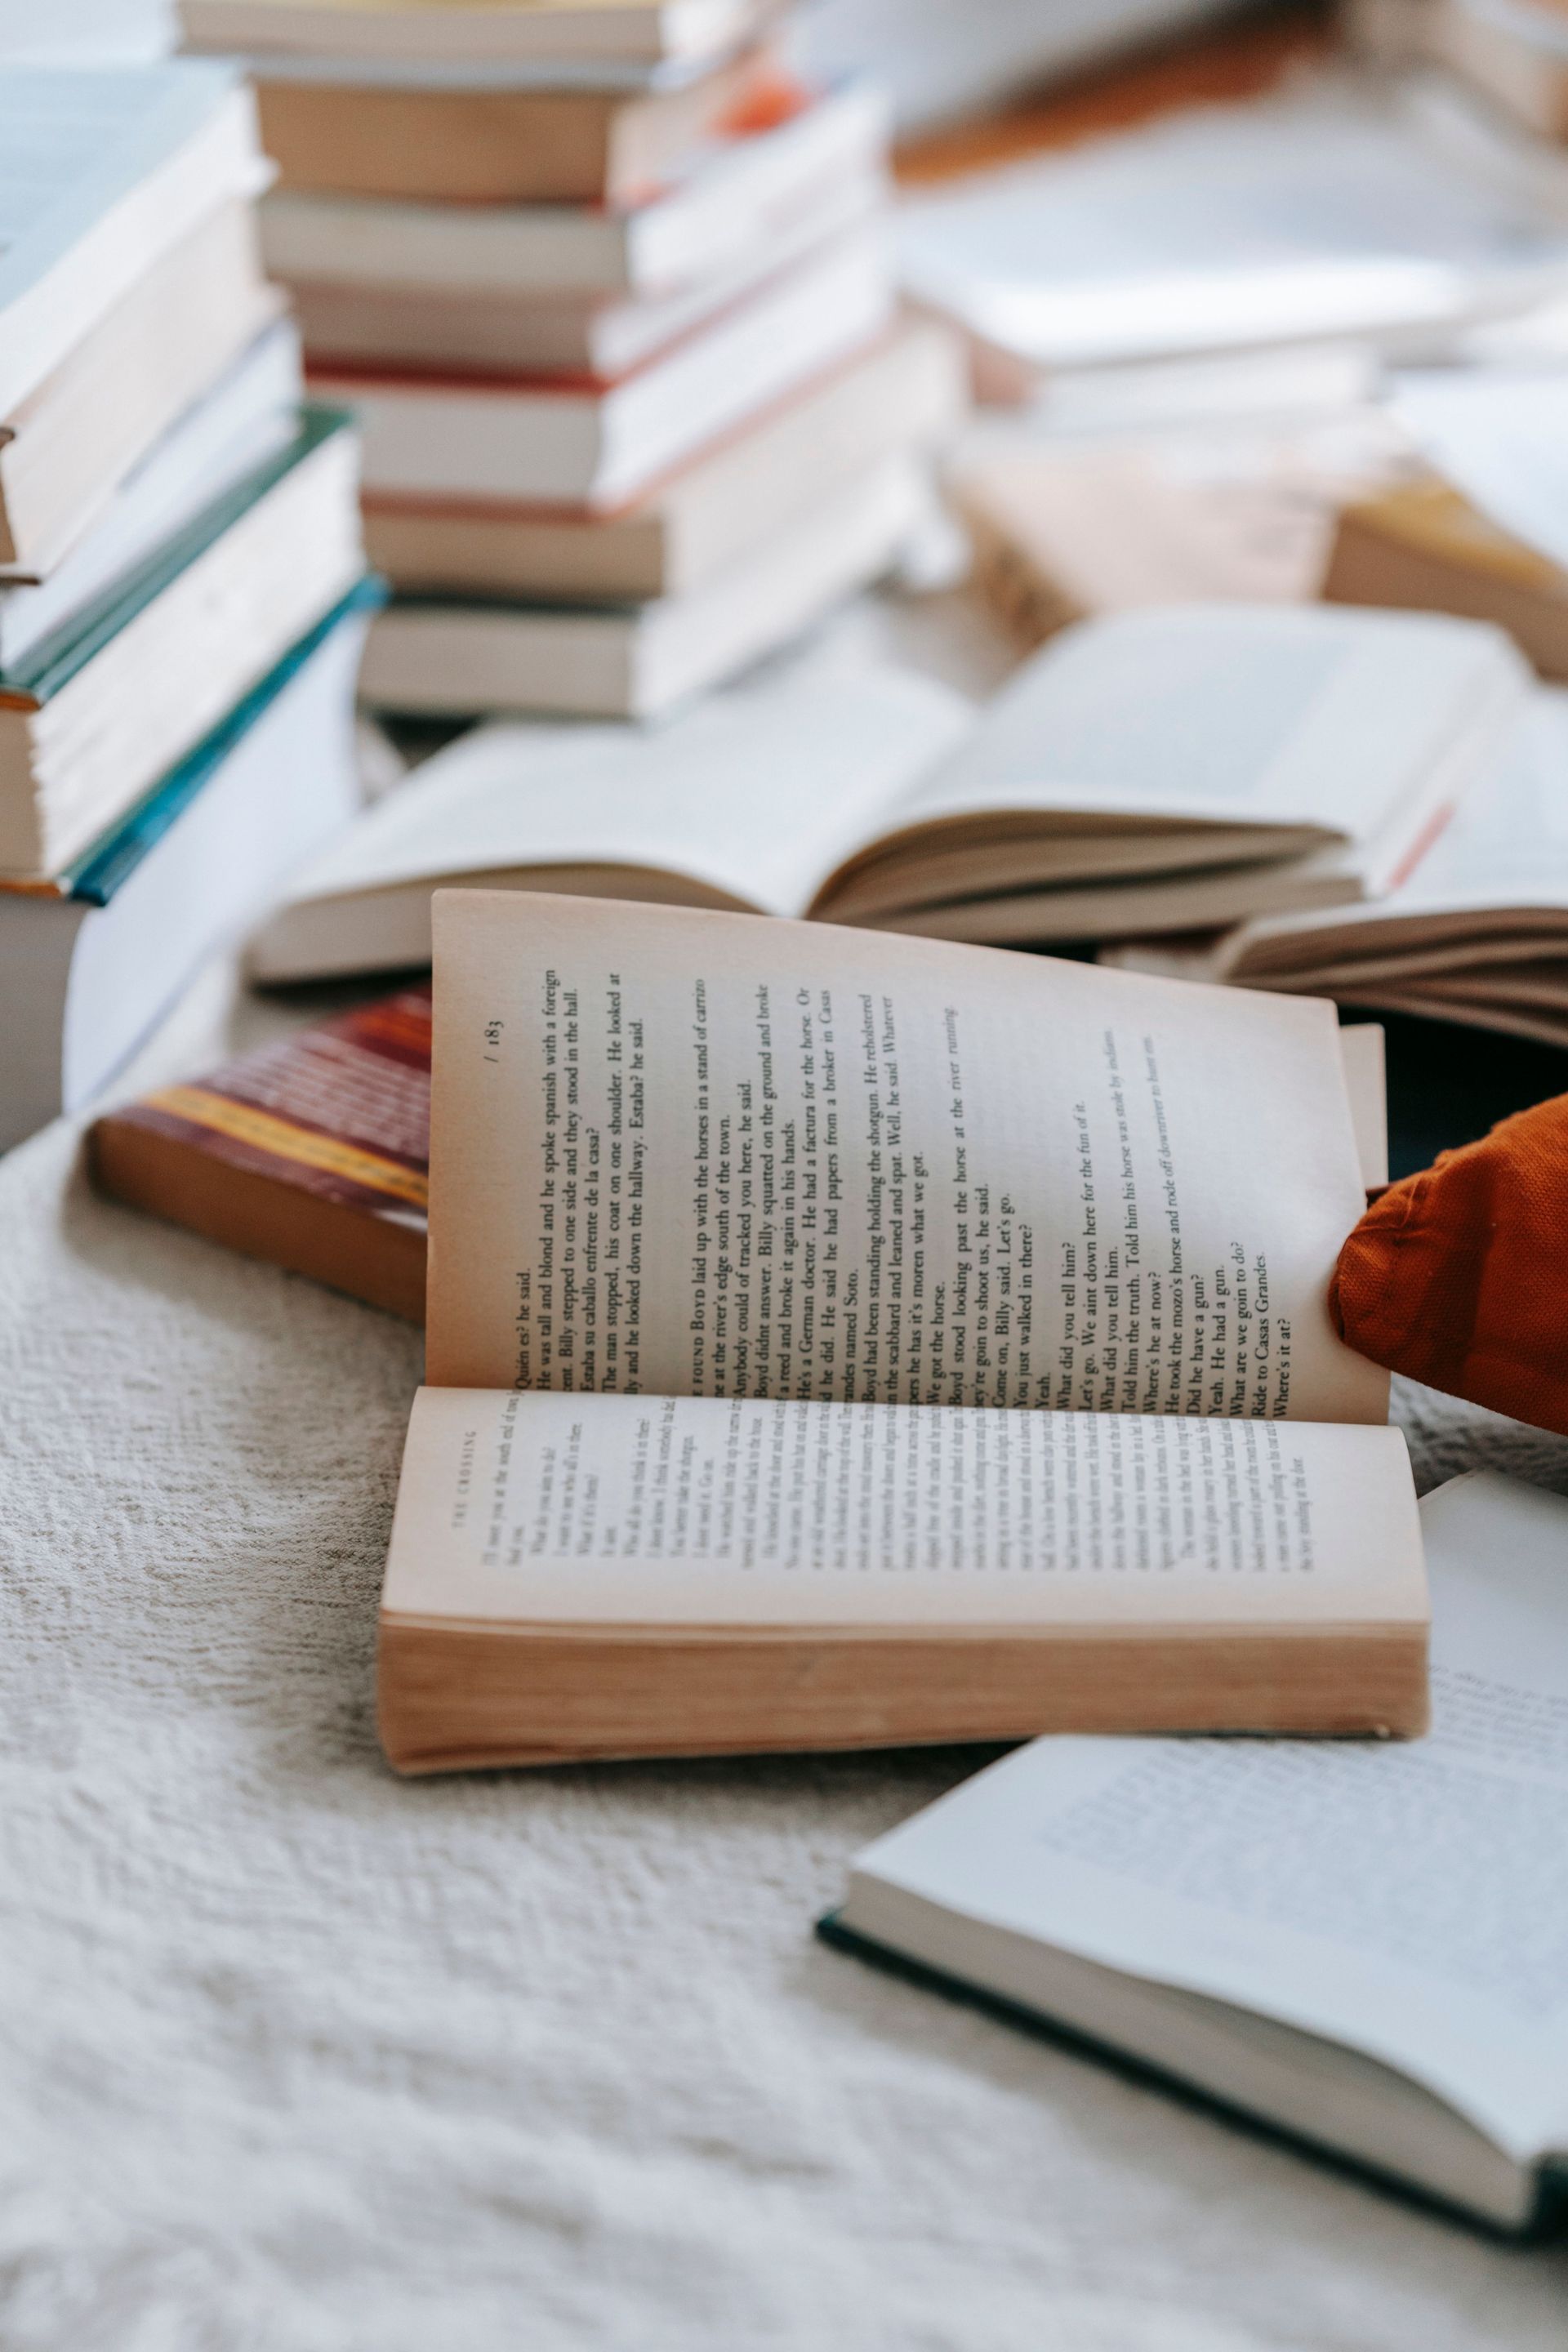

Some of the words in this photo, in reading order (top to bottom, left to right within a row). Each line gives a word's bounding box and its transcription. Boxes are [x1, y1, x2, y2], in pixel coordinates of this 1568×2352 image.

[541, 970, 560, 1016] foreign
[564, 989, 577, 1017] hall.
[607, 991, 621, 1034] looked
[485, 1021, 503, 1045] 183
[542, 1035, 556, 1066] with
[628, 1019, 643, 1049] said.
[693, 1045, 708, 1080] stand
[758, 1052, 777, 1099] ground
[822, 1049, 835, 1091] broker
[884, 1059, 898, 1087] said.
[950, 1062, 961, 1090] river
[542, 1072, 559, 1125] spanish
[564, 1067, 578, 1104] stood
[608, 1071, 621, 1135] shoulder.
[629, 1076, 644, 1129] Estaba?
[737, 1080, 751, 1110] said.
[564, 1111, 581, 1143] they
[719, 1116, 730, 1155] town.
[802, 1106, 816, 1152] factura
[823, 1113, 838, 1146] from
[866, 1090, 883, 1146] shotgun.
[887, 1111, 901, 1146] Well,
[541, 1132, 559, 1173] spoke
[586, 1128, 599, 1165] casa?
[694, 1115, 709, 1160] horses
[781, 1120, 795, 1164] hands.
[1077, 1134, 1090, 1153] fun
[628, 1136, 647, 1197] hallway.
[737, 1138, 753, 1174] here,
[892, 1153, 906, 1184] spat.
[913, 1152, 929, 1177] got.
[953, 1147, 967, 1183] horse
[1120, 1146, 1134, 1178] horse
[742, 1180, 755, 1207] you
[760, 1154, 777, 1215] squatted
[828, 1153, 843, 1200] papers
[1163, 1180, 1177, 1206] rode
[562, 1181, 577, 1209] side
[693, 1194, 707, 1227] with
[867, 1176, 884, 1231] holding
[975, 1184, 989, 1214] said.
[609, 1201, 620, 1232] coat
[715, 1209, 729, 1250] south
[911, 1209, 924, 1244] what
[1082, 1206, 1096, 1236] here
[582, 1212, 598, 1272] enfrente
[626, 1233, 641, 1274] down
[737, 1214, 751, 1267] tracked
[758, 1222, 777, 1256] Billy
[781, 1217, 798, 1255] again
[888, 1220, 902, 1267] leaned
[957, 1223, 972, 1252] past
[996, 1219, 1010, 1254] Let's
[1018, 1224, 1032, 1268] there?
[1125, 1234, 1139, 1267] Told
[538, 1237, 553, 1278] blond
[692, 1258, 706, 1284] laid
[714, 1256, 733, 1290] edge
[800, 1238, 816, 1290] doctor.
[866, 1235, 884, 1298] standing
[1062, 1243, 1076, 1277] him?
[1083, 1242, 1097, 1282] down
[1105, 1247, 1118, 1278] him.
[1169, 1237, 1183, 1274] horse
[516, 1268, 530, 1299] said.
[760, 1264, 772, 1319] answer.
[822, 1269, 836, 1298] said
[844, 1269, 858, 1306] Soto.
[913, 1250, 924, 1298] moren
[951, 1262, 971, 1316] looking
[974, 1271, 989, 1311] shoot
[996, 1263, 1010, 1294] said.
[1147, 1272, 1161, 1310] now?
[1191, 1275, 1209, 1308] gun?
[1215, 1266, 1230, 1295] gun.
[1254, 1252, 1268, 1312] Grandes.
[560, 1268, 579, 1321] stepped
[581, 1277, 596, 1326] caballo
[604, 1267, 623, 1326] stopped,
[625, 1280, 640, 1325] looked
[777, 1277, 793, 1317] broke
[929, 1282, 945, 1325] horse.
[1061, 1284, 1076, 1307] tell
[1083, 1288, 1097, 1316] aint
[1104, 1285, 1118, 1307] tell
[1126, 1276, 1140, 1316] truth.
[1169, 1278, 1183, 1328] mozo's
[1234, 1289, 1252, 1319] goin
[537, 1316, 551, 1336] tall
[713, 1295, 727, 1338] river's
[734, 1294, 749, 1332] could
[799, 1295, 814, 1353] German
[864, 1303, 880, 1335] been
[908, 1303, 923, 1324] it's
[995, 1301, 1013, 1335] Billy
[1017, 1294, 1031, 1346] walked
[558, 1326, 577, 1357] Billy
[607, 1333, 617, 1361] man
[755, 1324, 770, 1361] didnt
[820, 1338, 835, 1363] did.
[843, 1313, 858, 1358] named
[885, 1303, 901, 1365] scabbard
[906, 1330, 921, 1352] has
[951, 1326, 965, 1363] stood
[973, 1336, 991, 1366] goin
[1189, 1328, 1204, 1361] have
[1254, 1318, 1269, 1361] Casas
[515, 1351, 531, 1389] Quién
[541, 1342, 551, 1365] was
[581, 1350, 596, 1392] Estaba
[693, 1337, 704, 1383] FOUND
[733, 1337, 751, 1397] Anybody
[777, 1353, 791, 1381] reed
[1016, 1352, 1032, 1376] just
[1124, 1348, 1138, 1375] him
[1236, 1352, 1247, 1374] are
[602, 1366, 617, 1392] The
[755, 1365, 773, 1398] Boyd
[797, 1371, 813, 1400] He's
[863, 1369, 882, 1401] Boyd
[949, 1372, 968, 1405] Boyd
[994, 1370, 1009, 1407] Come
[1036, 1373, 1051, 1409] Yeah.
[1058, 1374, 1073, 1410] What
[1145, 1358, 1160, 1413] Where's
[1167, 1360, 1181, 1389] took
[1276, 1361, 1290, 1418] Where's
[1015, 1382, 1030, 1408] You
[1080, 1379, 1095, 1410] Let's
[1102, 1376, 1116, 1411] What
[1125, 1380, 1138, 1412] Told
[1187, 1389, 1202, 1414] Did
[1210, 1378, 1224, 1414] Yeah.
[1230, 1379, 1245, 1415] What
[1253, 1385, 1267, 1416] Ride
[457, 1431, 477, 1494] CROSSING
